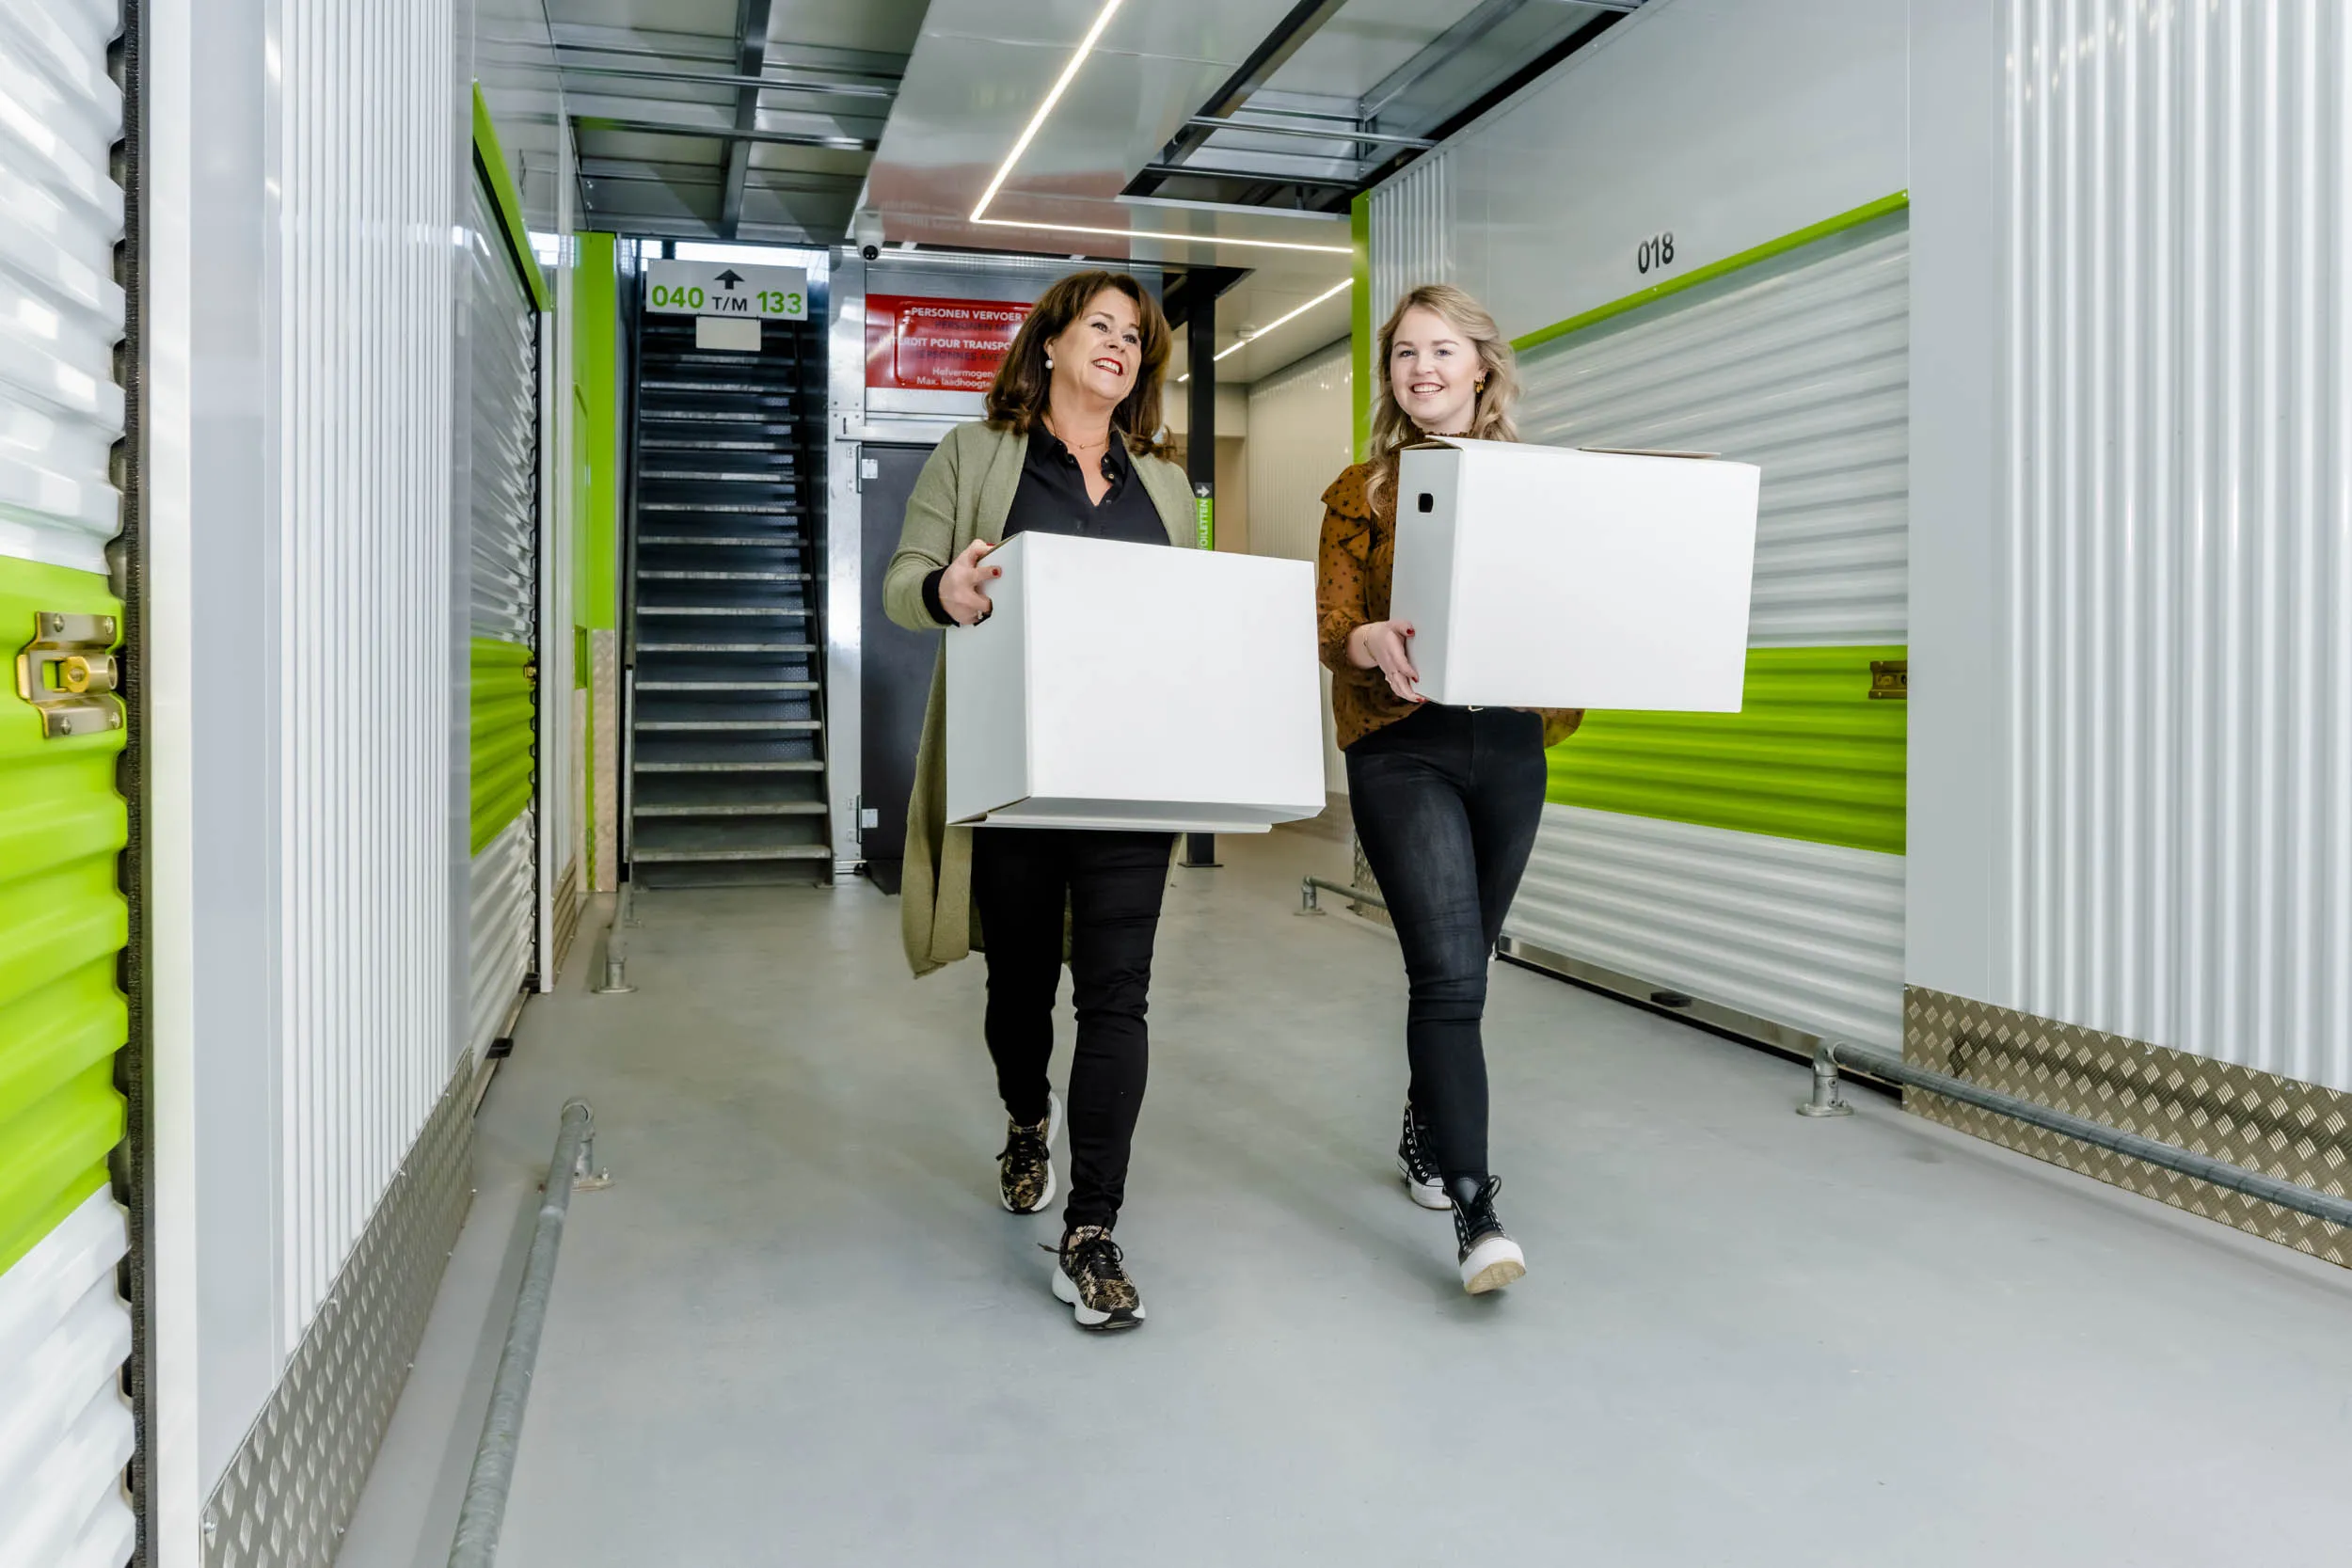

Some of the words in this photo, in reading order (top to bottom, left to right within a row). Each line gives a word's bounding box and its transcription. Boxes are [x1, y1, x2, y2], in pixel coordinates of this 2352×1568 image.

[1638, 231, 1674, 274] 018
[652, 285, 705, 309] 040
[712, 296, 747, 311] T/M
[756, 291, 802, 314] 133
[912, 307, 969, 319] PERSONEN
[972, 310, 1023, 322] VERVOER
[930, 338, 961, 348] POUR
